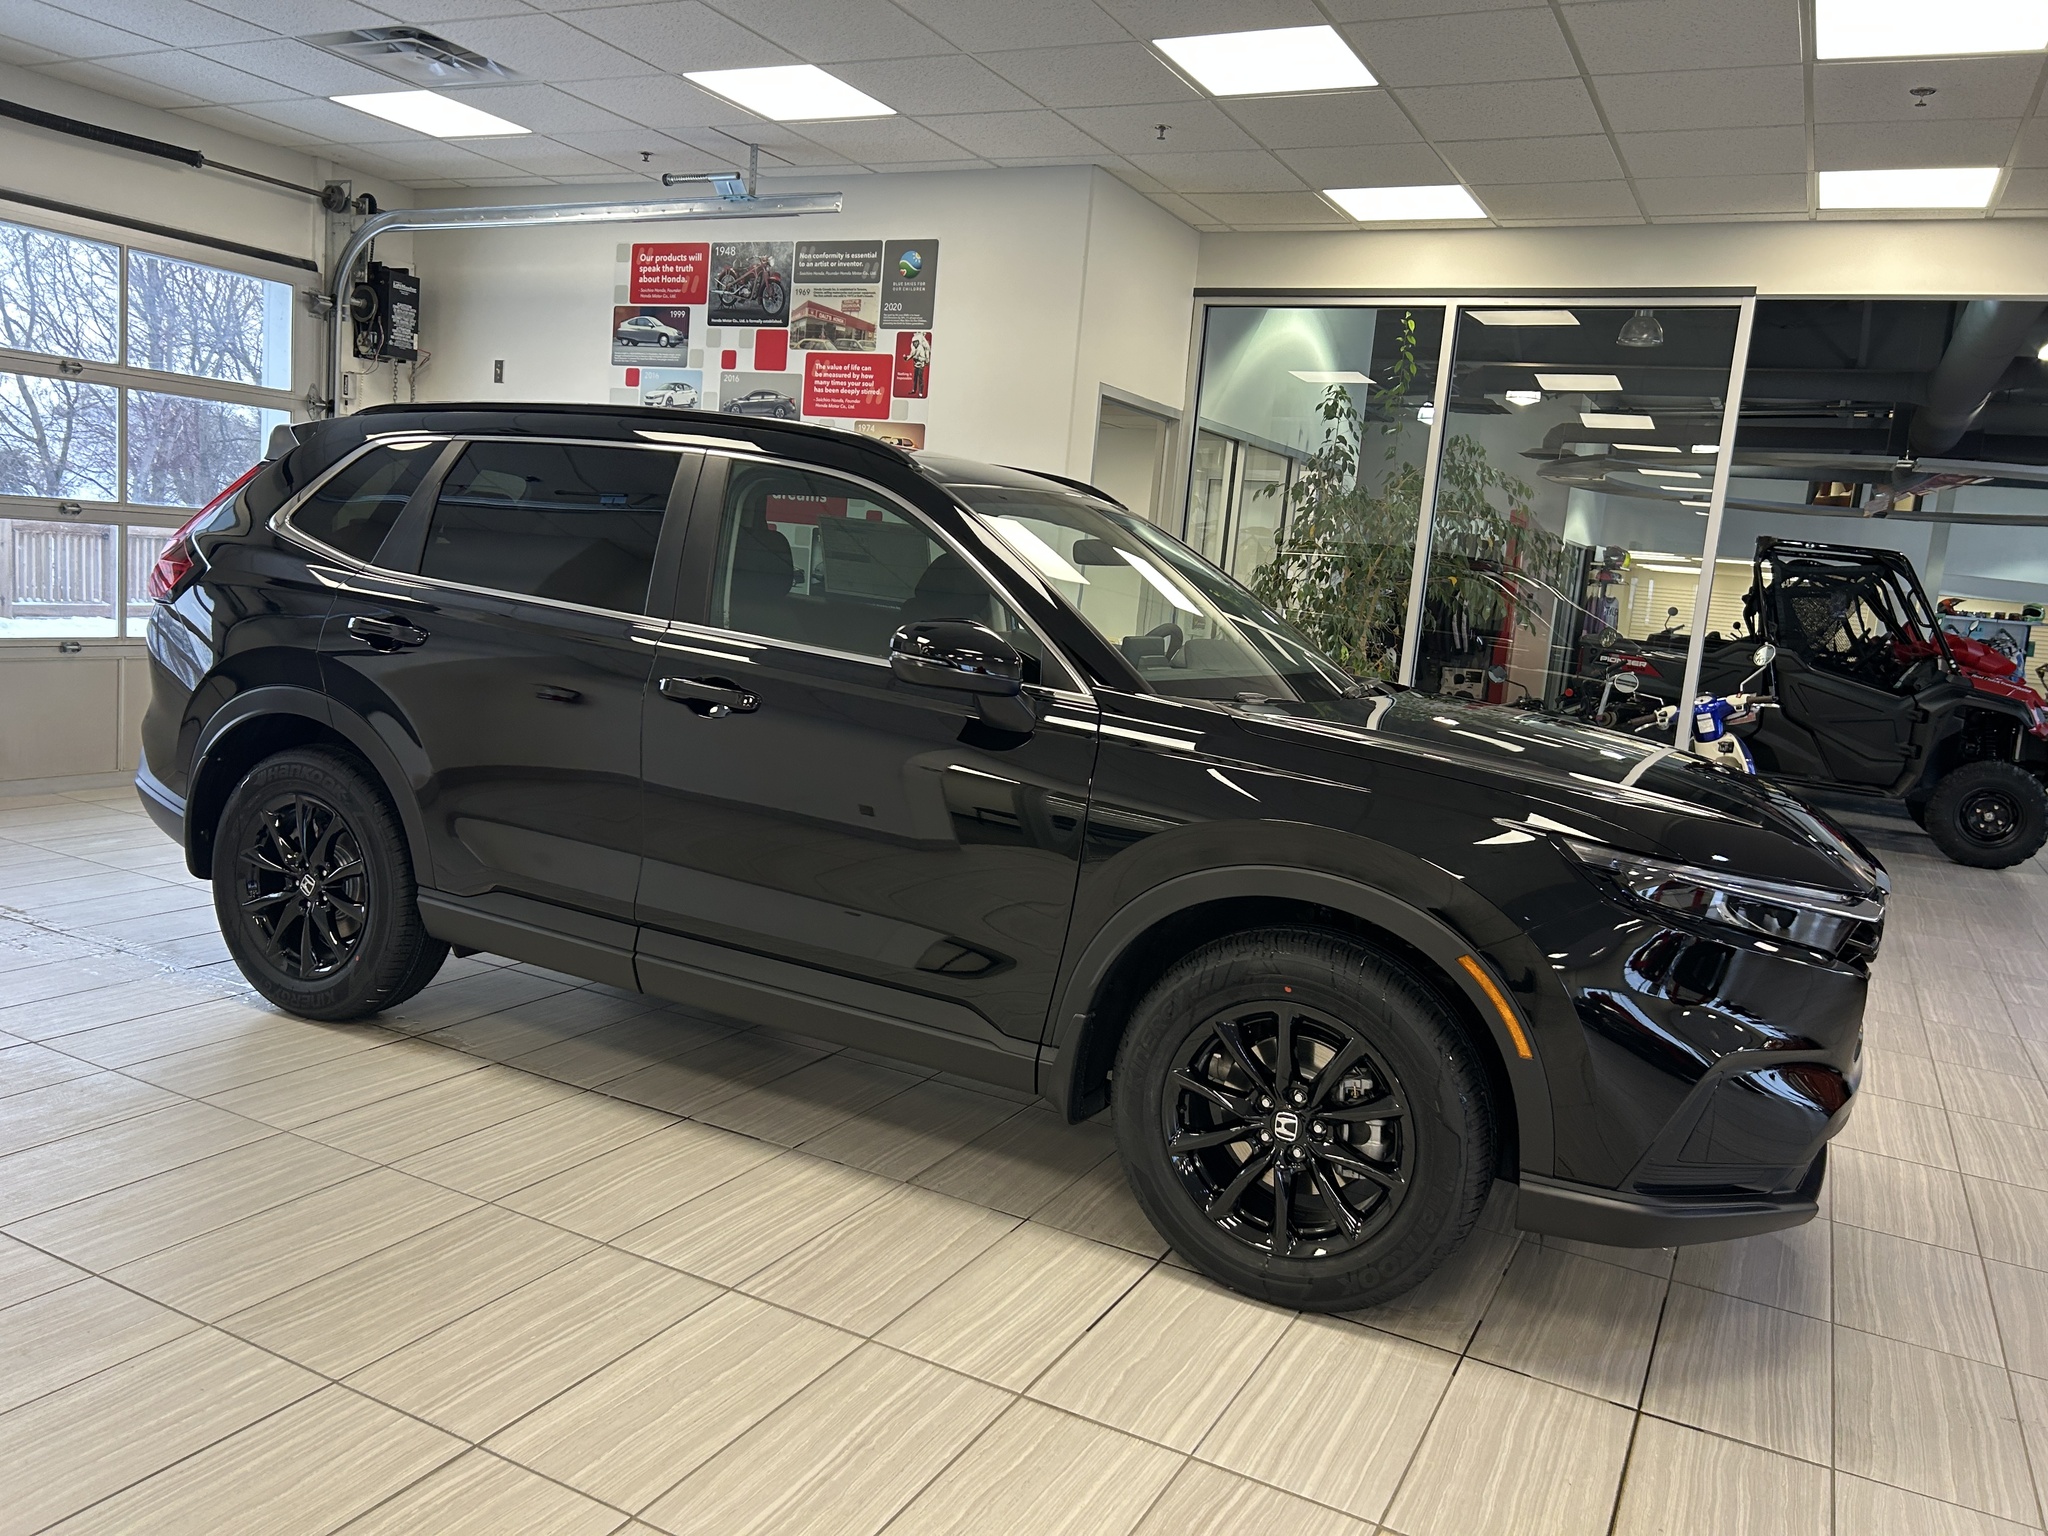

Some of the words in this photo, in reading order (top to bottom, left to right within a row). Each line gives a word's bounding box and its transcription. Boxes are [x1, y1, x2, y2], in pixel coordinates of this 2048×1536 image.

[715, 246, 736, 256] 1948
[640, 253, 653, 262] Our
[655, 253, 687, 263] products
[688, 253, 702, 261] will
[812, 252, 844, 260] conformity
[639, 264, 660, 274] speak
[662, 264, 674, 272] the
[675, 264, 693, 272] truth
[883, 303, 902, 311] 2020
[644, 372, 659, 380] 2016
[723, 374, 740, 382] 2016
